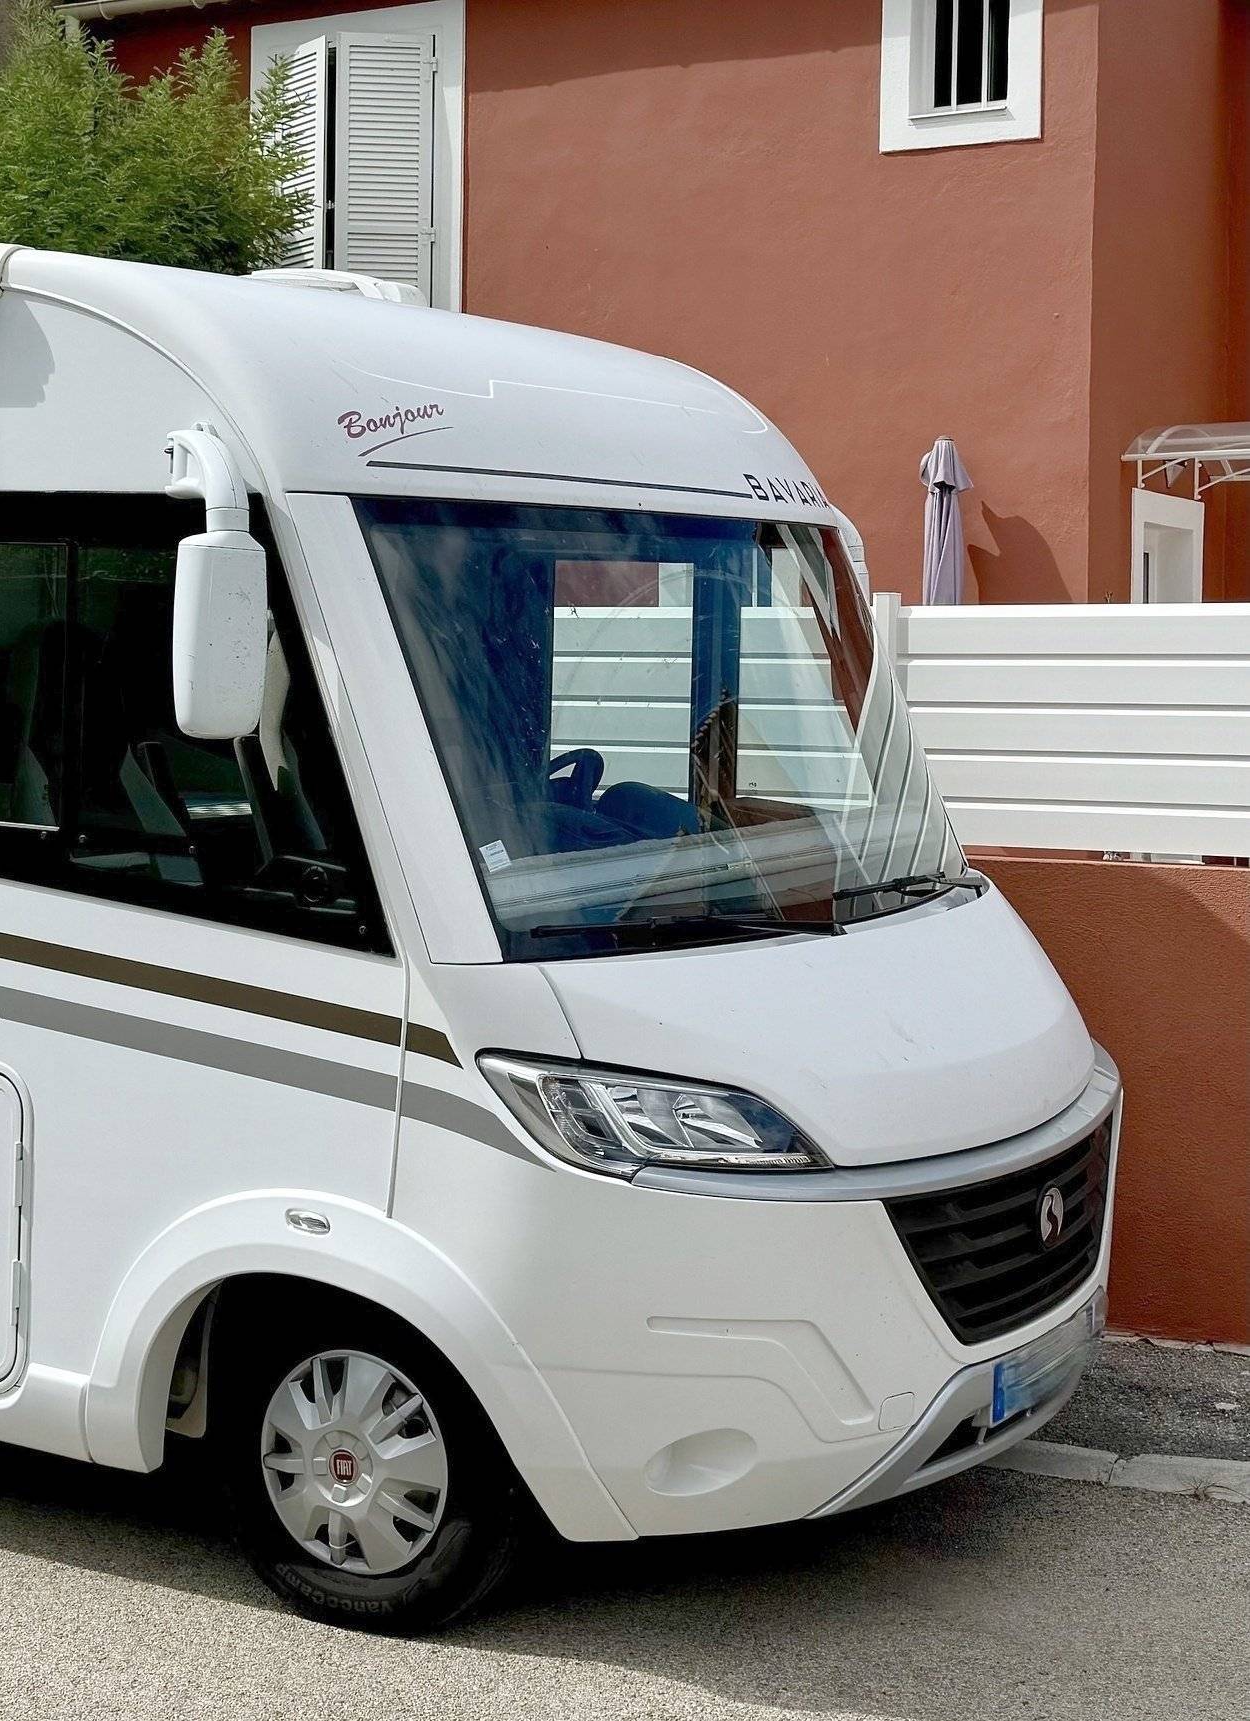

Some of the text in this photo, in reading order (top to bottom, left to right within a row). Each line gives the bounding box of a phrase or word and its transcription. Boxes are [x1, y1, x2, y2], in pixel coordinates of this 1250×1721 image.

[337, 403, 445, 439] Bonjour
[742, 473, 830, 508] BAVARIA
[336, 1459, 352, 1476] FIAT
